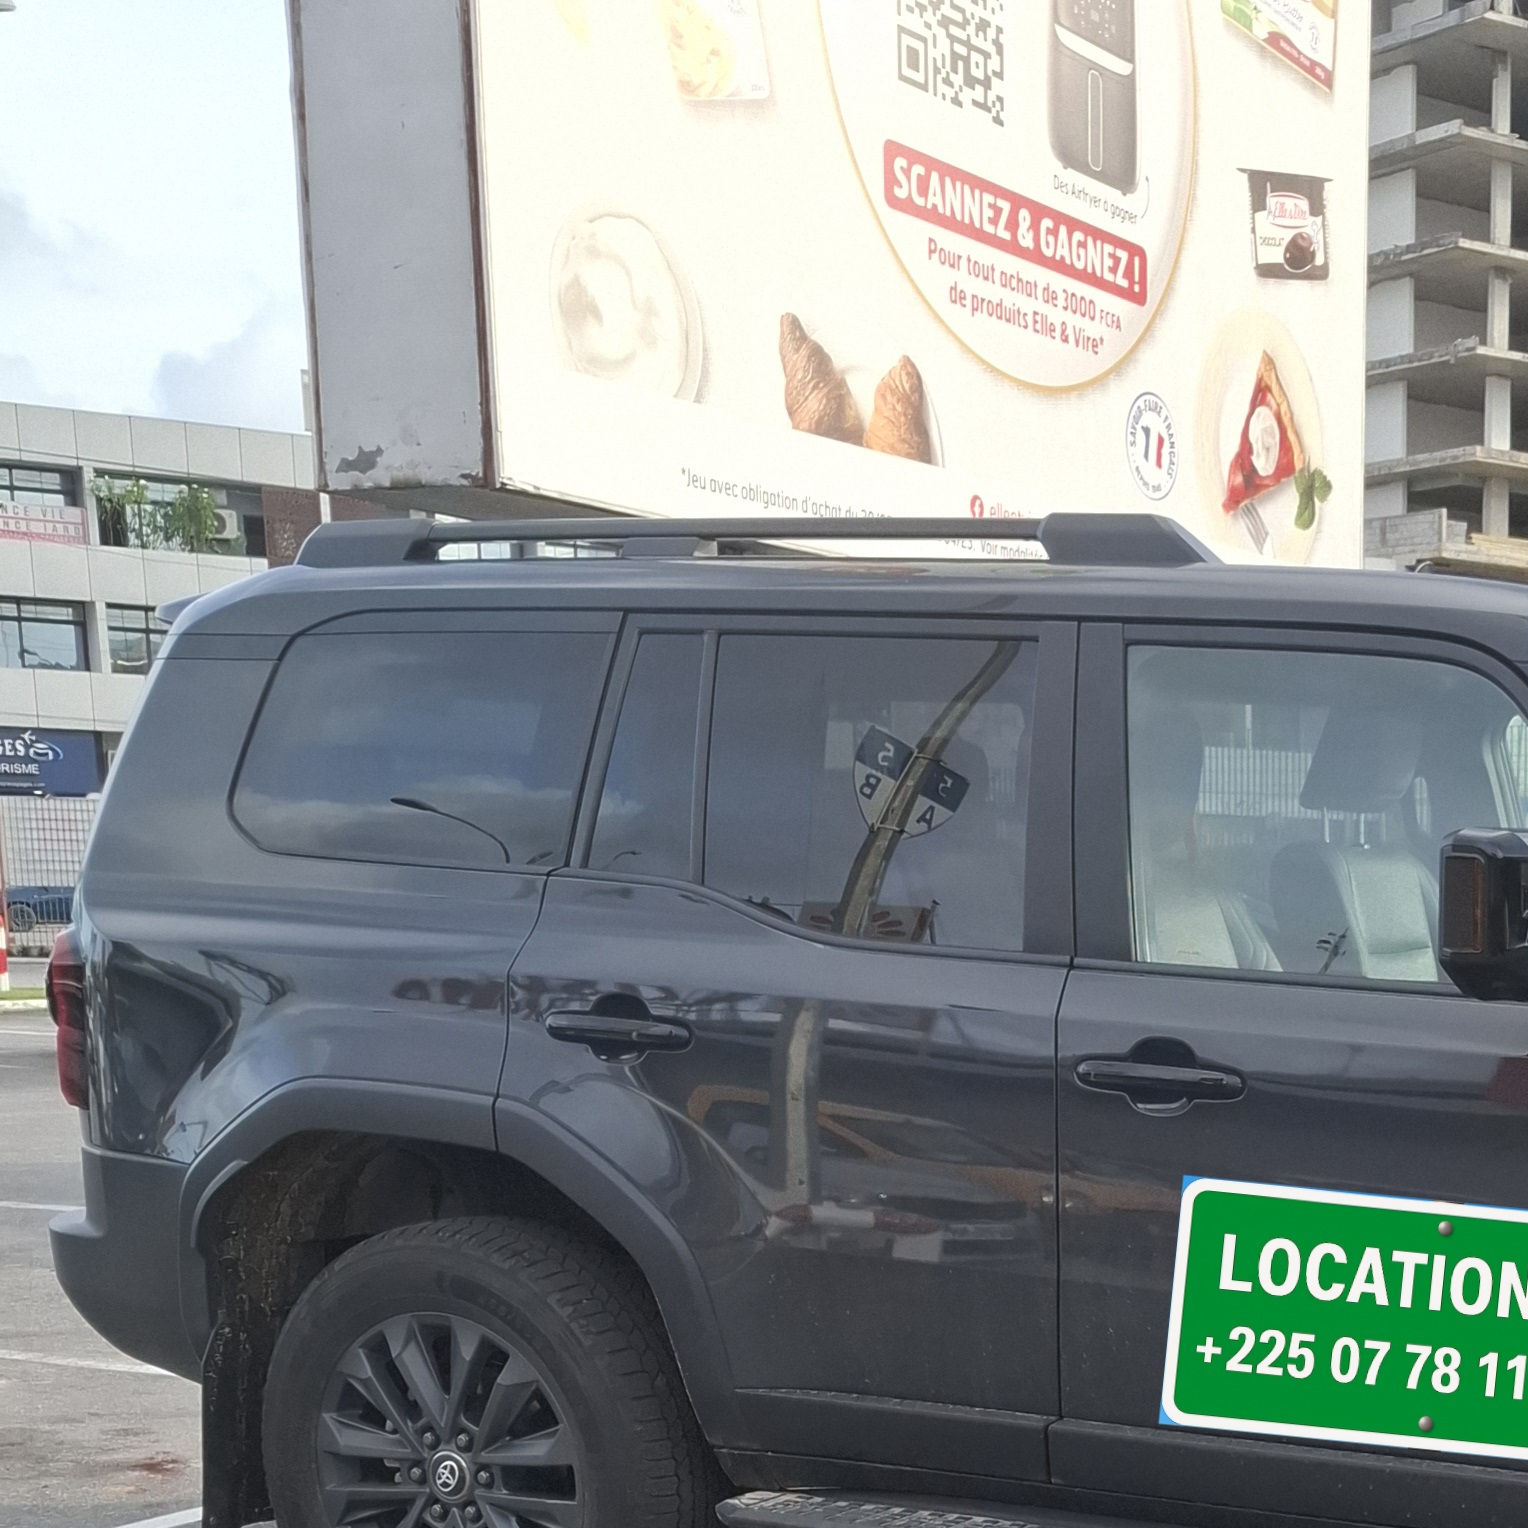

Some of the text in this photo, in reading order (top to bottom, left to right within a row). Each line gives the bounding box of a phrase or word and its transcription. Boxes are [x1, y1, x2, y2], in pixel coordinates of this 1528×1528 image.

[893, 156, 1012, 241] SCANNEZ
[1017, 207, 1034, 250] &
[1053, 174, 1069, 194] Des
[1070, 182, 1102, 211] Airfryer
[1110, 202, 1138, 224] gagner
[928, 237, 1122, 332] Pour tout achat de 3000 FCFA
[949, 281, 967, 305] de
[971, 292, 1029, 330] produits
[1033, 310, 1056, 340] Elle
[1060, 321, 1069, 344] &
[41, 507, 65, 520] VIE
[710, 476, 738, 499] avec
[741, 482, 799, 511] obligation
[0, 762, 41, 775] RISME
